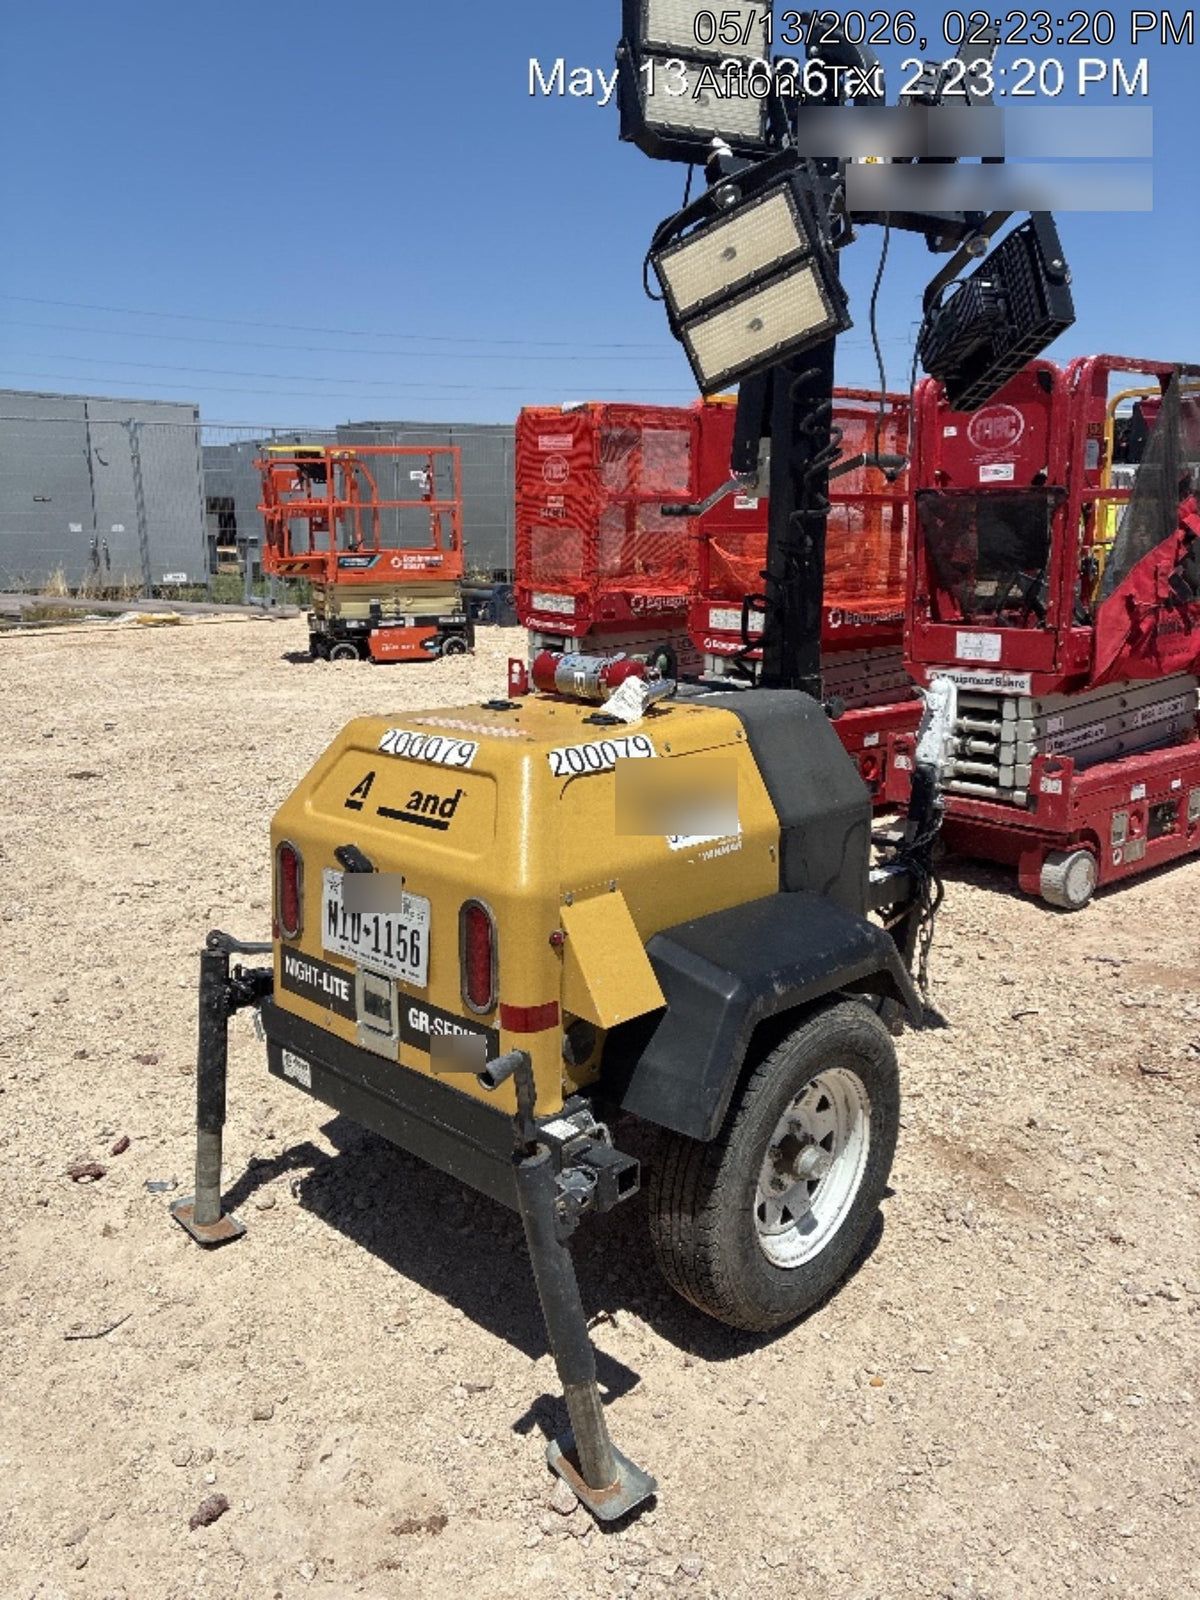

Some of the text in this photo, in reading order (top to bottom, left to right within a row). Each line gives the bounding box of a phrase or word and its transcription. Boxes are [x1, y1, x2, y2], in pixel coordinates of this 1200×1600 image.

[378, 729, 476, 768] 200079
[546, 735, 652, 777] 200079
[285, 955, 350, 1002] NIGHT-LITE
[408, 1007, 488, 1057] GR-SE
